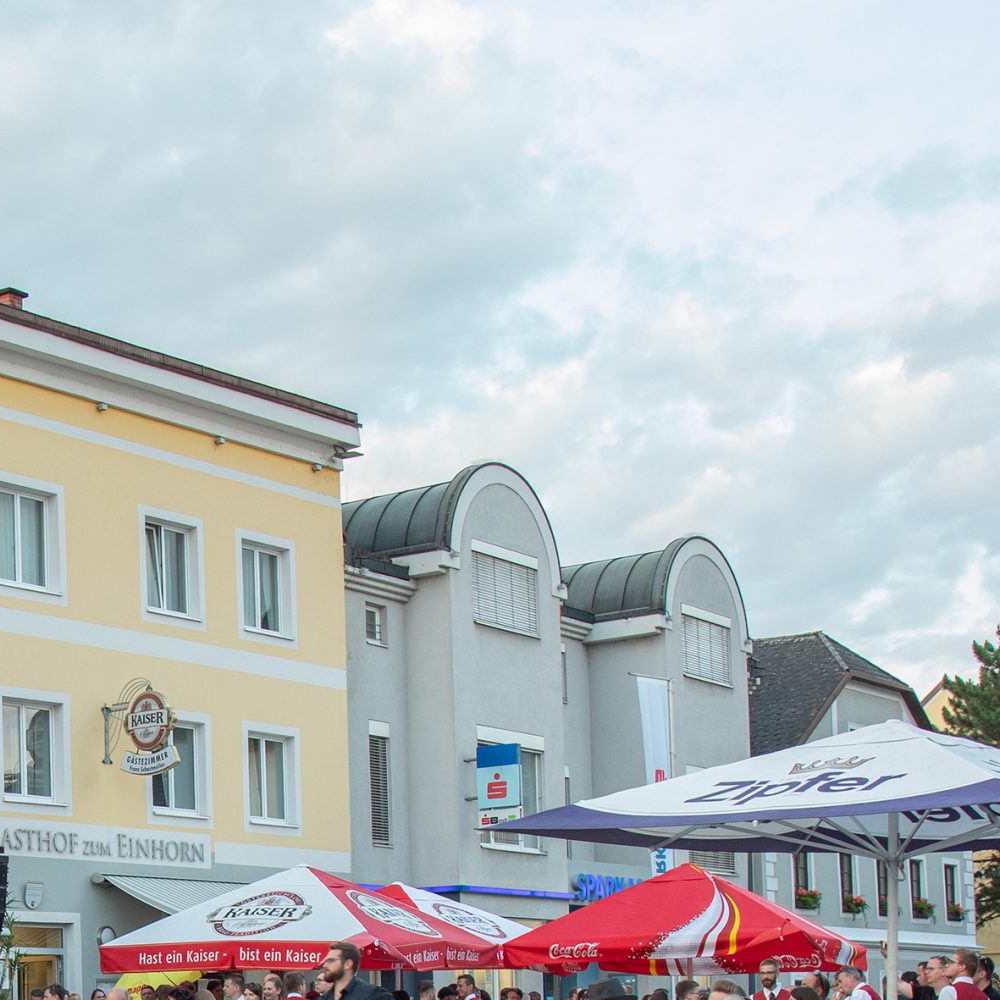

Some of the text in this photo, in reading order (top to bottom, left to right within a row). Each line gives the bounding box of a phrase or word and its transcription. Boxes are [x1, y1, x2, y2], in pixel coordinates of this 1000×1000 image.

[131, 711, 164, 727] KAISER
[126, 751, 169, 765] GÄSTEZIMMER
[684, 771, 908, 806] Zipfer
[116, 833, 205, 863] EINHORN
[223, 907, 297, 918] KAISER
[139, 952, 162, 965] Hast
[166, 950, 182, 964] ein
[186, 949, 219, 963] Kaiser
[240, 947, 260, 961] bist
[264, 948, 281, 961] ein
[286, 949, 322, 963] Kaiser
[549, 942, 600, 959] Coca-Cola
